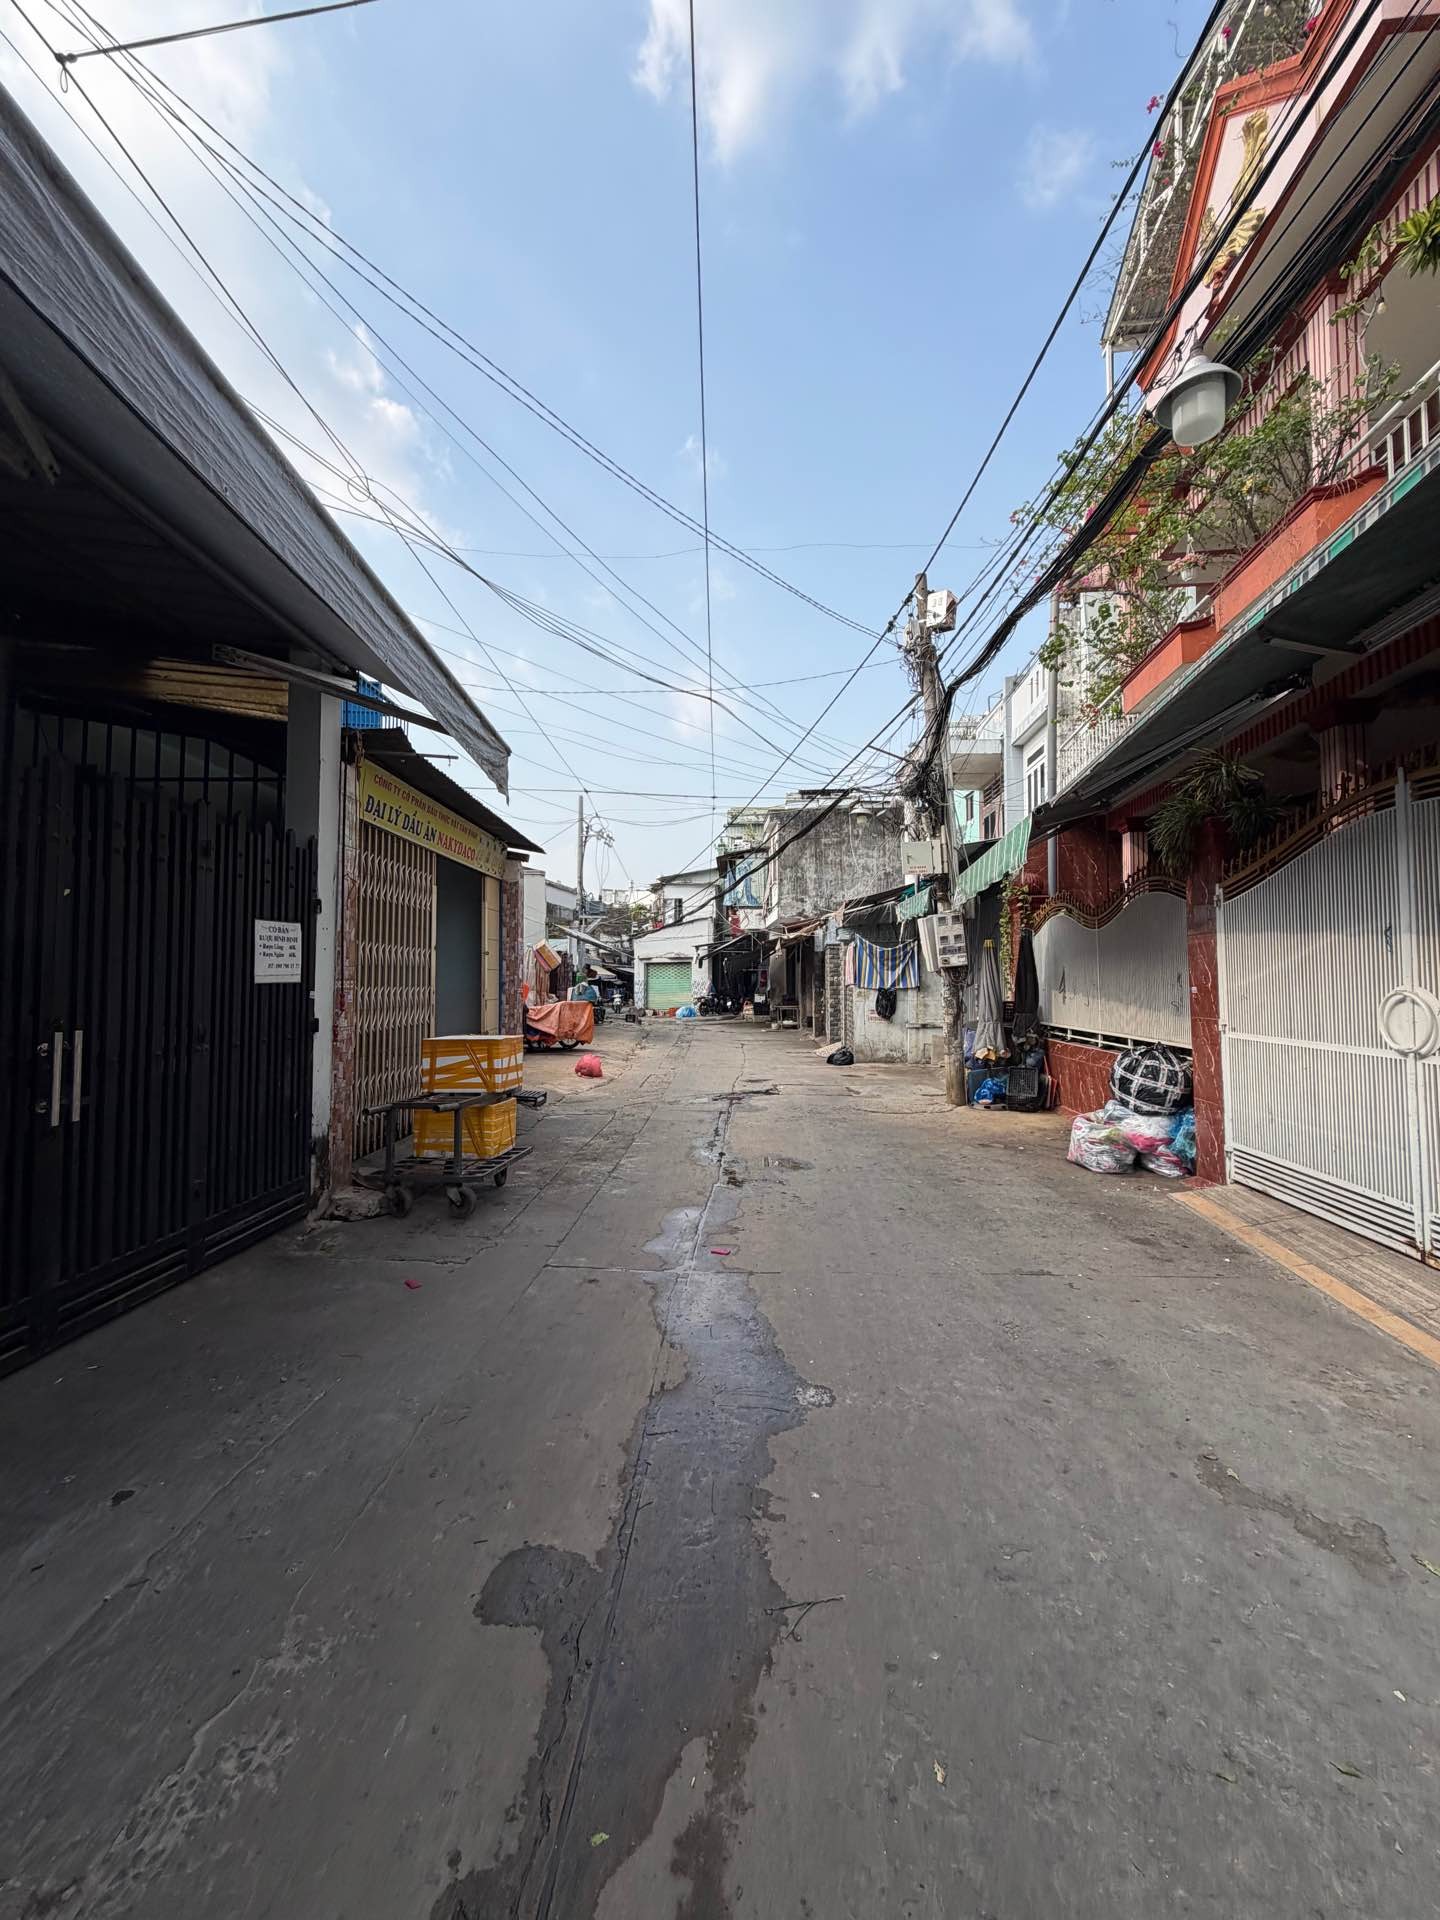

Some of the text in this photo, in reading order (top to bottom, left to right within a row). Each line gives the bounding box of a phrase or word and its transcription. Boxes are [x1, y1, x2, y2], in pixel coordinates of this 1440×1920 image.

[393, 784, 402, 797] TY
[365, 794, 387, 822] ĐẠI
[387, 805, 402, 826] LÝ
[437, 832, 476, 861] NAKYDACO
